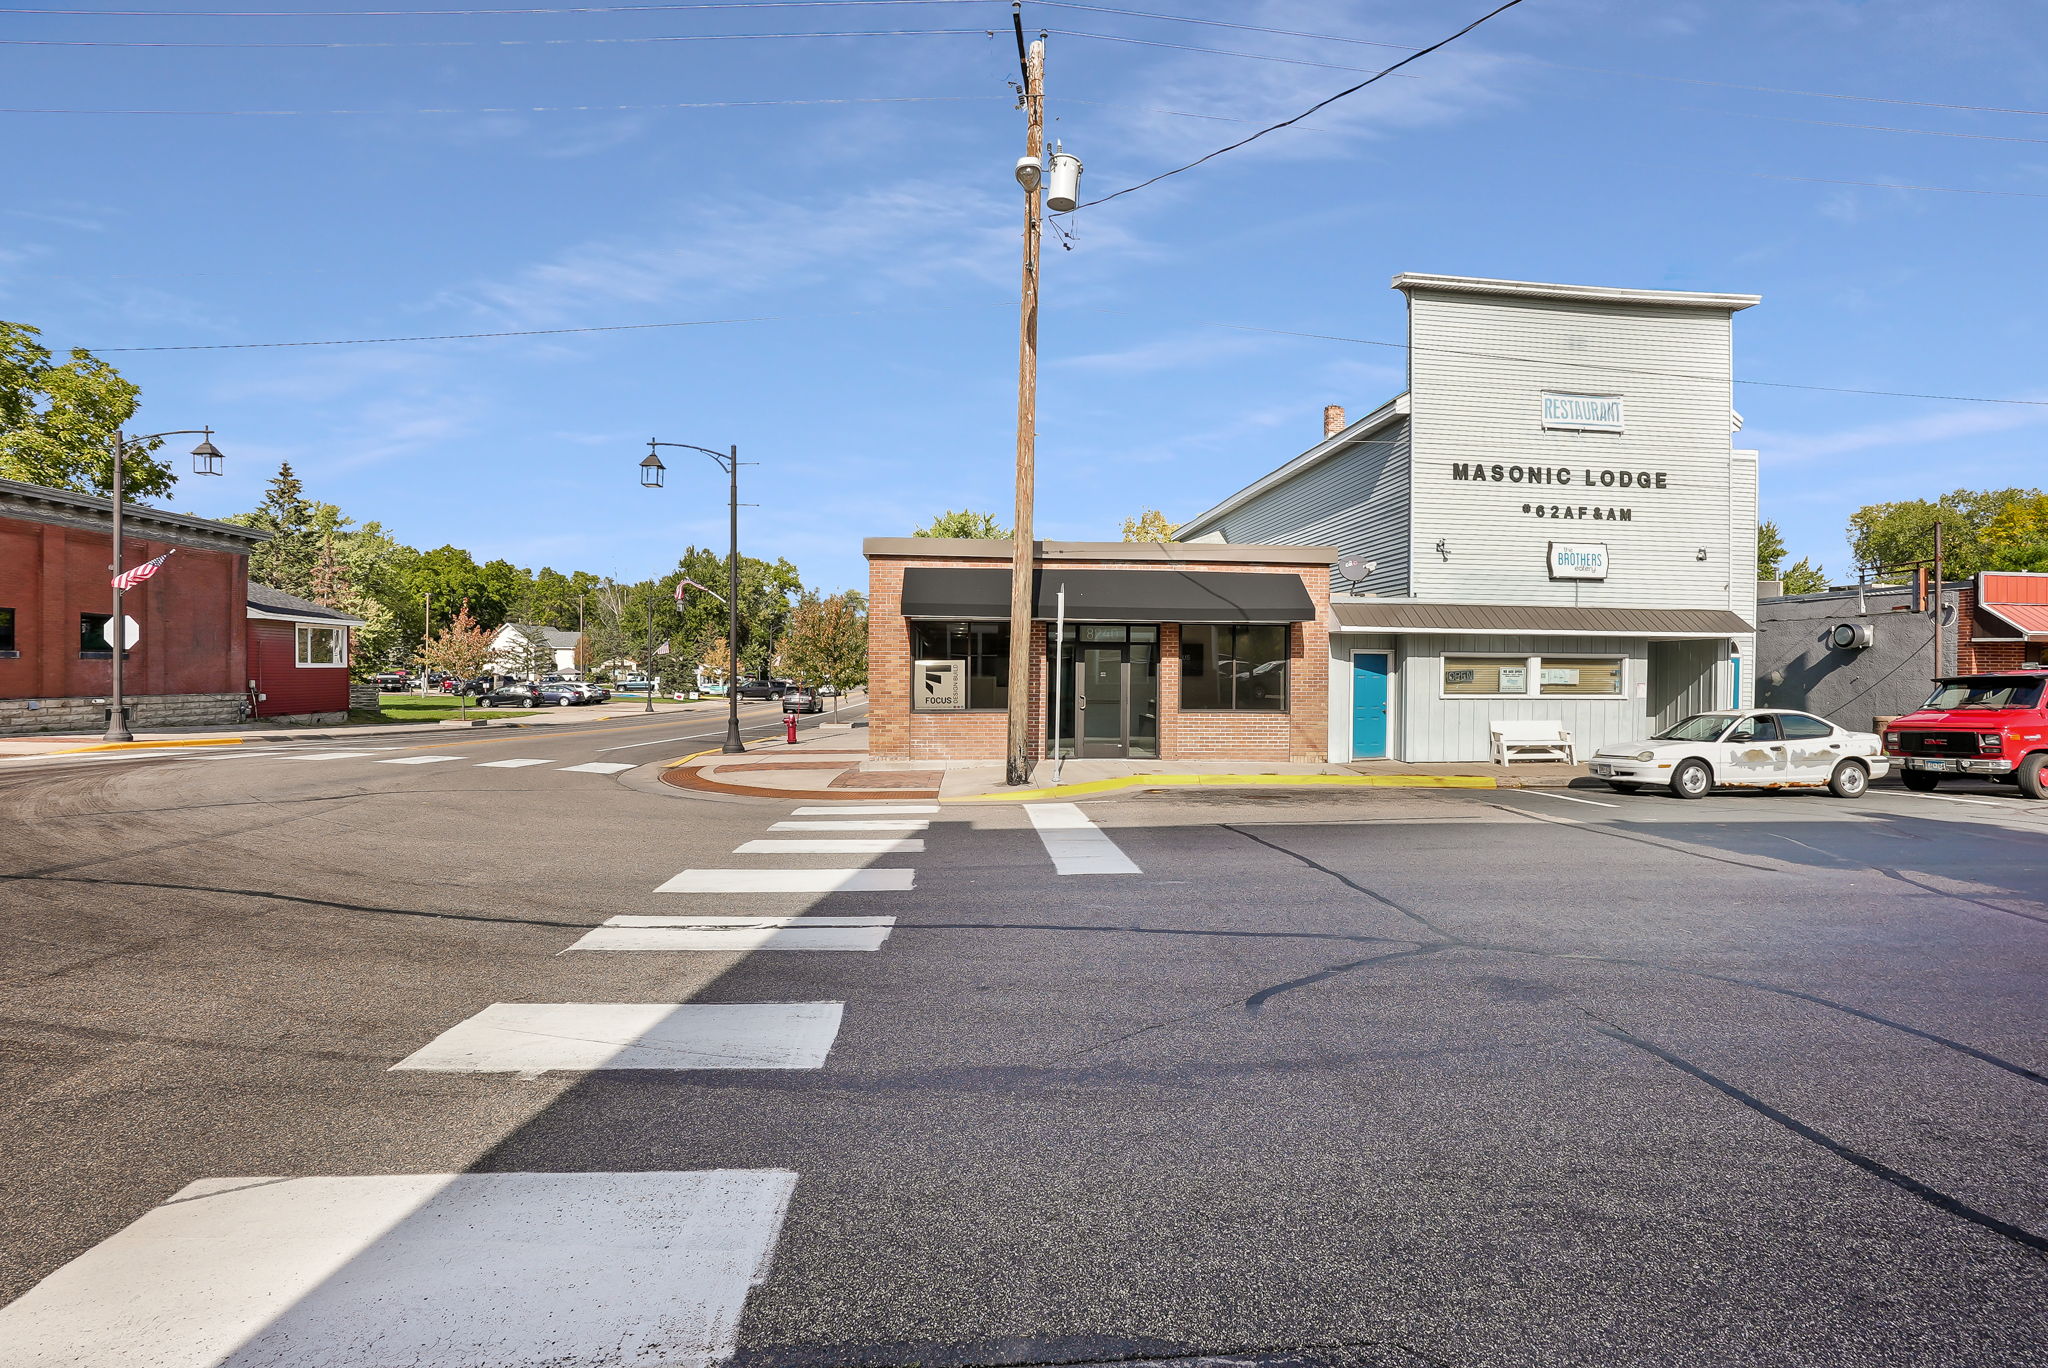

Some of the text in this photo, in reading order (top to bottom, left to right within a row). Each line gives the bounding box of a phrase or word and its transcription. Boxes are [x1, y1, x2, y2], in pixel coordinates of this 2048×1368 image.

[1544, 398, 1621, 422] RESTAURANT
[1452, 463, 1668, 489] MASONIC LODGE
[1558, 552, 1602, 567] BROTHERS
[1574, 566, 1597, 574] eatery
